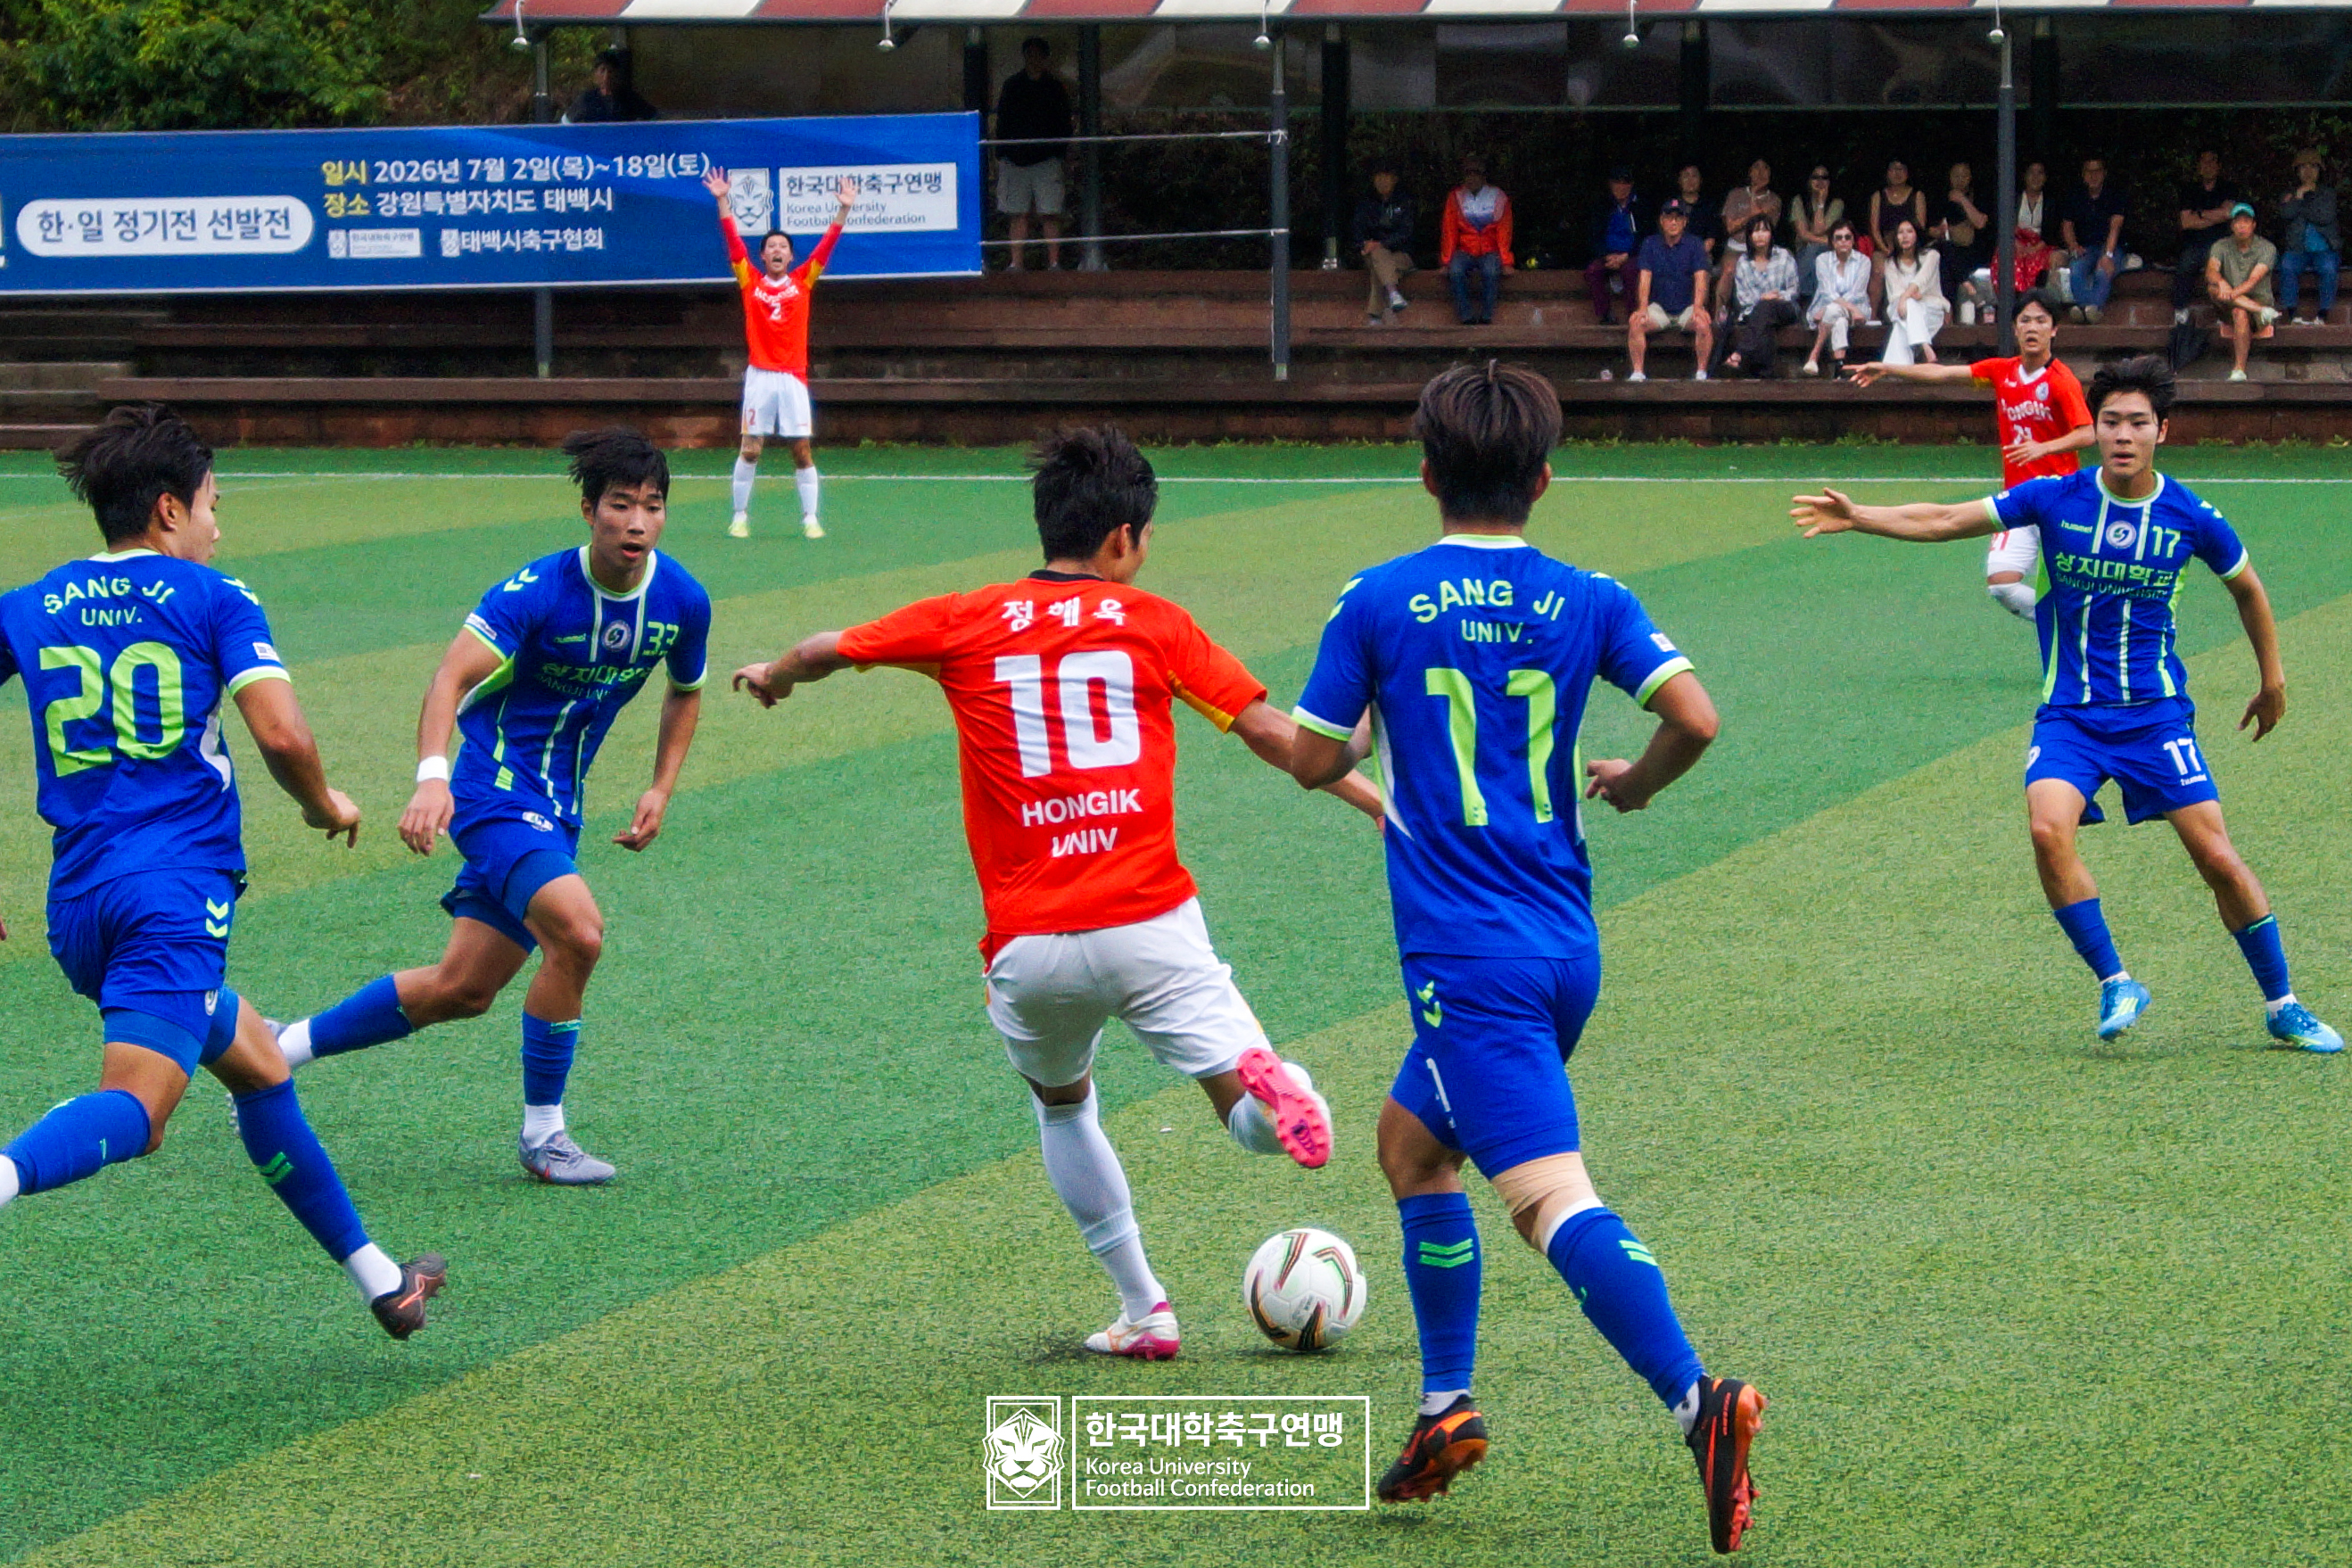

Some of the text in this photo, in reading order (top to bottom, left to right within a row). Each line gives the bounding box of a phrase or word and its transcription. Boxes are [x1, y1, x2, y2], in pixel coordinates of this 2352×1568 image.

[322, 160, 367, 186] 일시
[374, 158, 459, 184] 2026년
[466, 157, 505, 183] 7월
[324, 186, 613, 218] 장소 강원특별자치도 태백시
[786, 202, 821, 214] Korea
[846, 212, 927, 226] onfederation
[113, 207, 197, 243] 정기전
[208, 206, 291, 241] 선발전
[460, 226, 604, 252] 태백시축구협회
[2152, 524, 2182, 558] 17
[2055, 551, 2175, 588] 상지대학교
[44, 575, 175, 615] SANG JI
[1408, 577, 1566, 623] SANG JI
[81, 606, 143, 626] UNIV.
[1461, 618, 1533, 644] UNIV.
[39, 641, 185, 778] 20
[994, 650, 1141, 778] 10
[1425, 667, 1556, 827] 11
[2163, 738, 2201, 775] 17
[1021, 788, 1143, 827] HONGIK
[1052, 827, 1118, 858] UNIV
